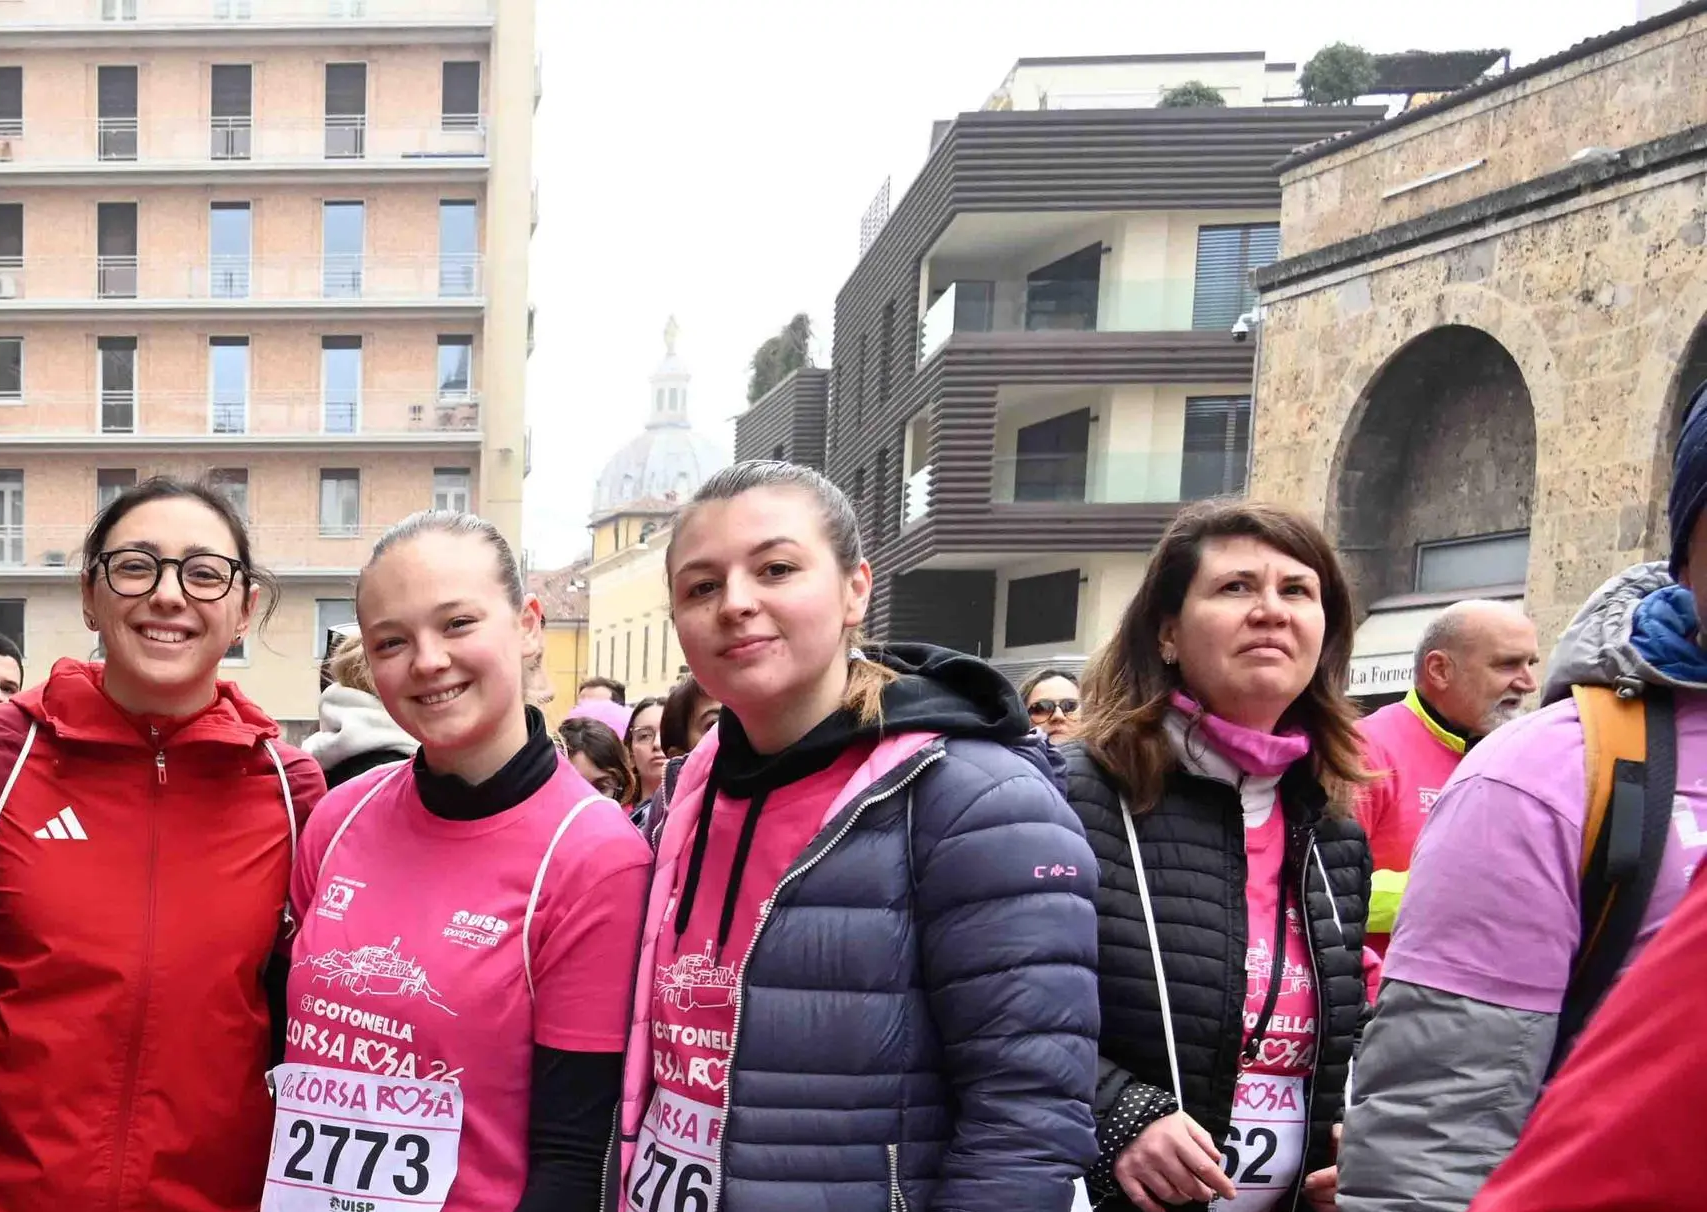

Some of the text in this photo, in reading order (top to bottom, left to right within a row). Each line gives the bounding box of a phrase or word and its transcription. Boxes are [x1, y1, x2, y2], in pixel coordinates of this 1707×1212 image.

[1350, 668, 1367, 685] La
[313, 999, 414, 1042] COTONELLA
[350, 1037, 417, 1080] ROSA
[280, 1073, 455, 1119] la CORSA ROSA
[1233, 1082, 1297, 1111] ROSA
[283, 1119, 431, 1196] 2773
